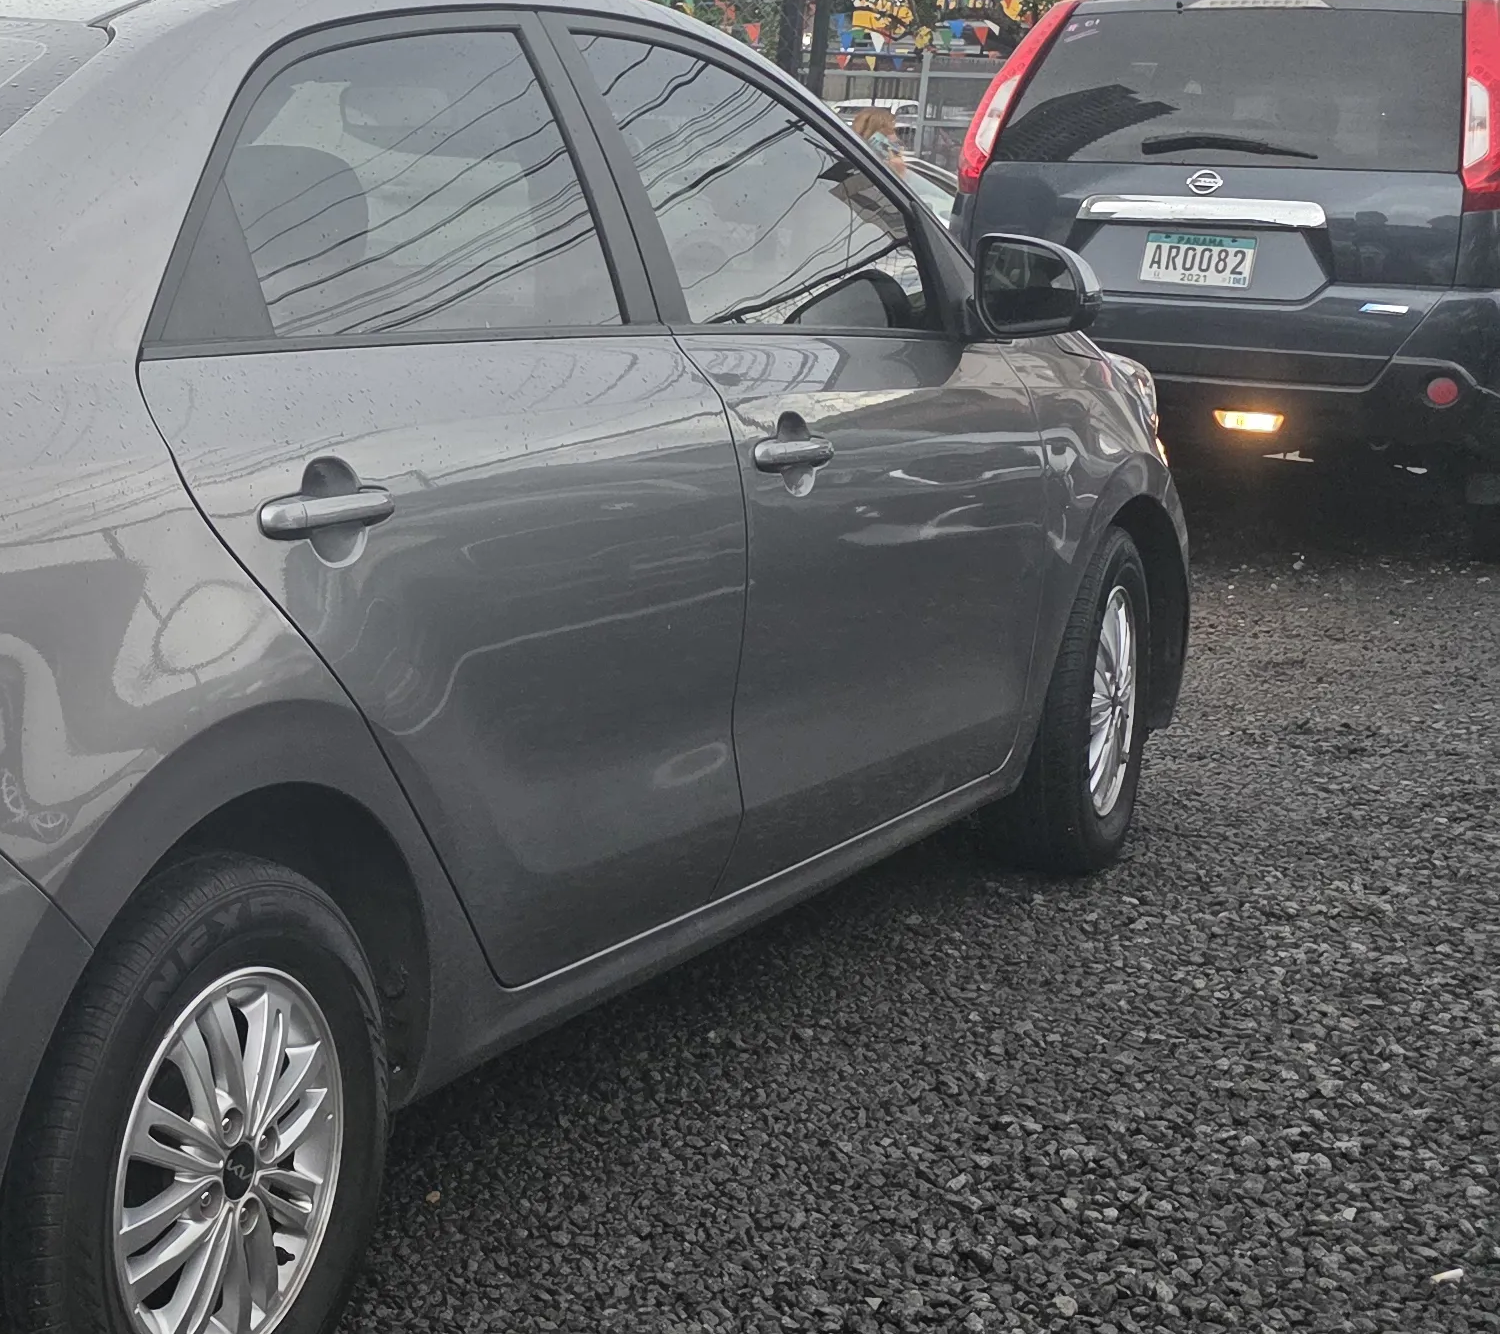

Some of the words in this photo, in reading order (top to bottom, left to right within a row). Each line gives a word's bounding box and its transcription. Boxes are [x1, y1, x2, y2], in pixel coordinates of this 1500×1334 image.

[1176, 235, 1225, 247] PANAMA
[1148, 244, 1247, 276] AR0082
[1179, 273, 1207, 283] 2021
[143, 894, 290, 1013] NEXE
